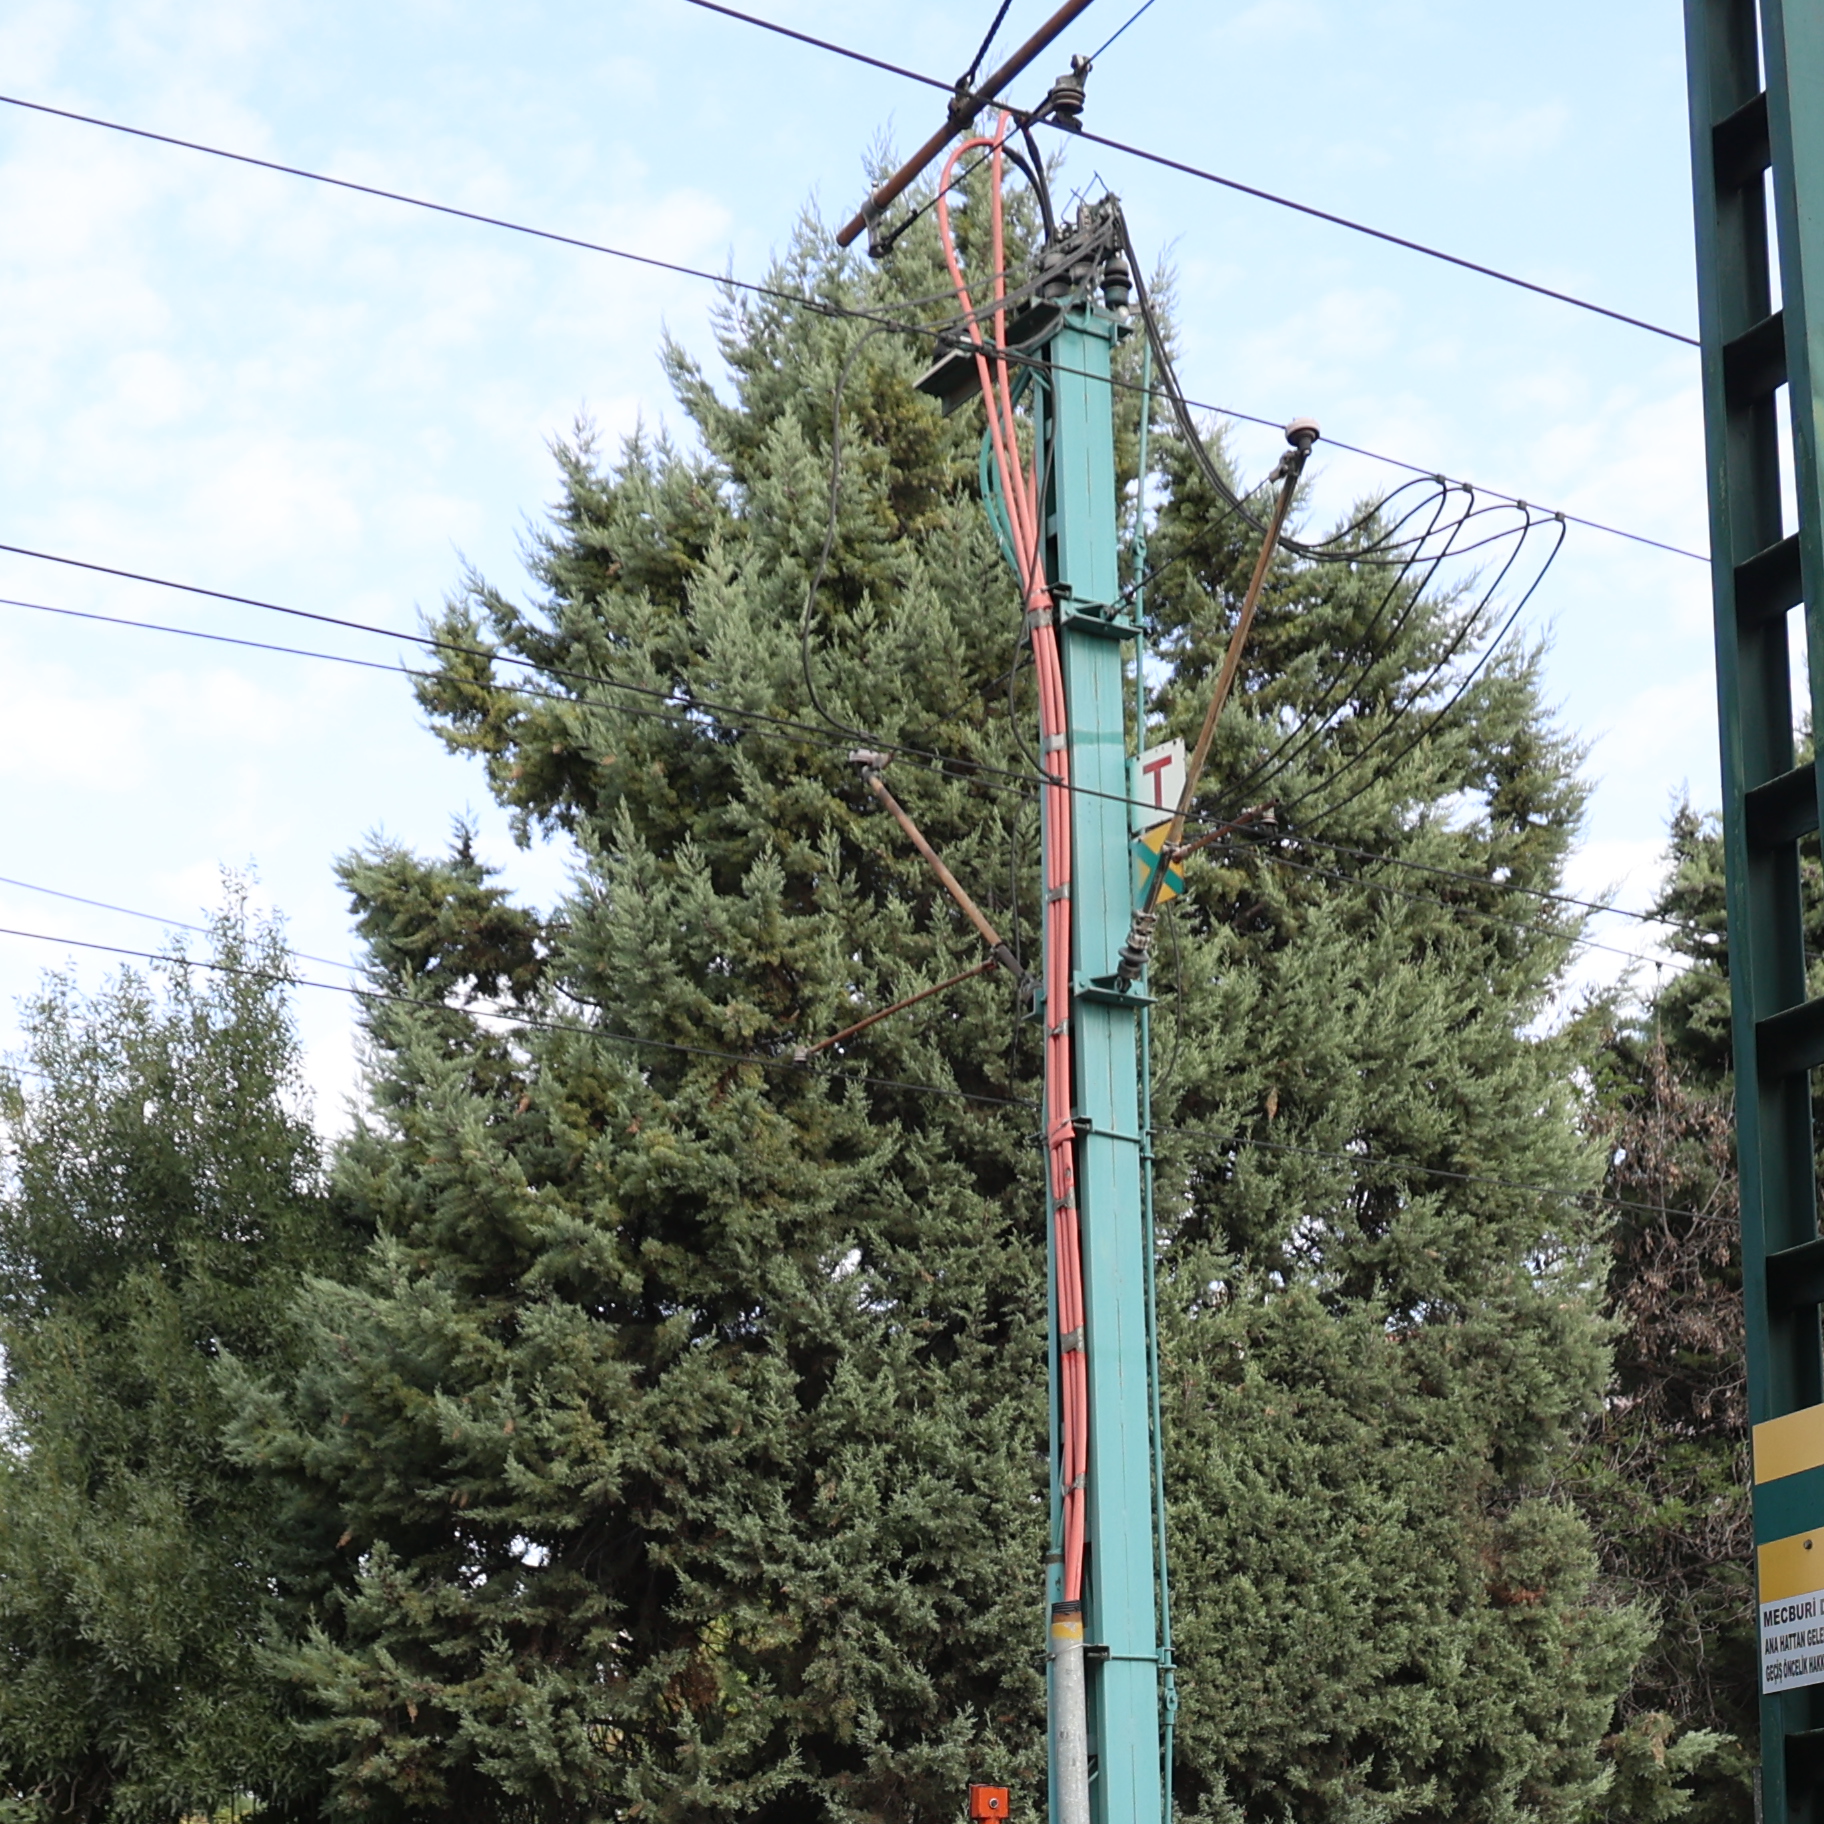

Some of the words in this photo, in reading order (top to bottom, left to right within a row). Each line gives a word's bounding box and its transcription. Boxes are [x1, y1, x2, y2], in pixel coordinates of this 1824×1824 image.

[1143, 754, 1173, 809] T
[1763, 1597, 1817, 1628] MECBURİ
[1765, 1636, 1779, 1655] ANA
[1779, 1630, 1806, 1652] HATTAN
[1766, 1659, 1783, 1685] GEÇİŞ
[1783, 1655, 1809, 1678] ÖNCELİK
